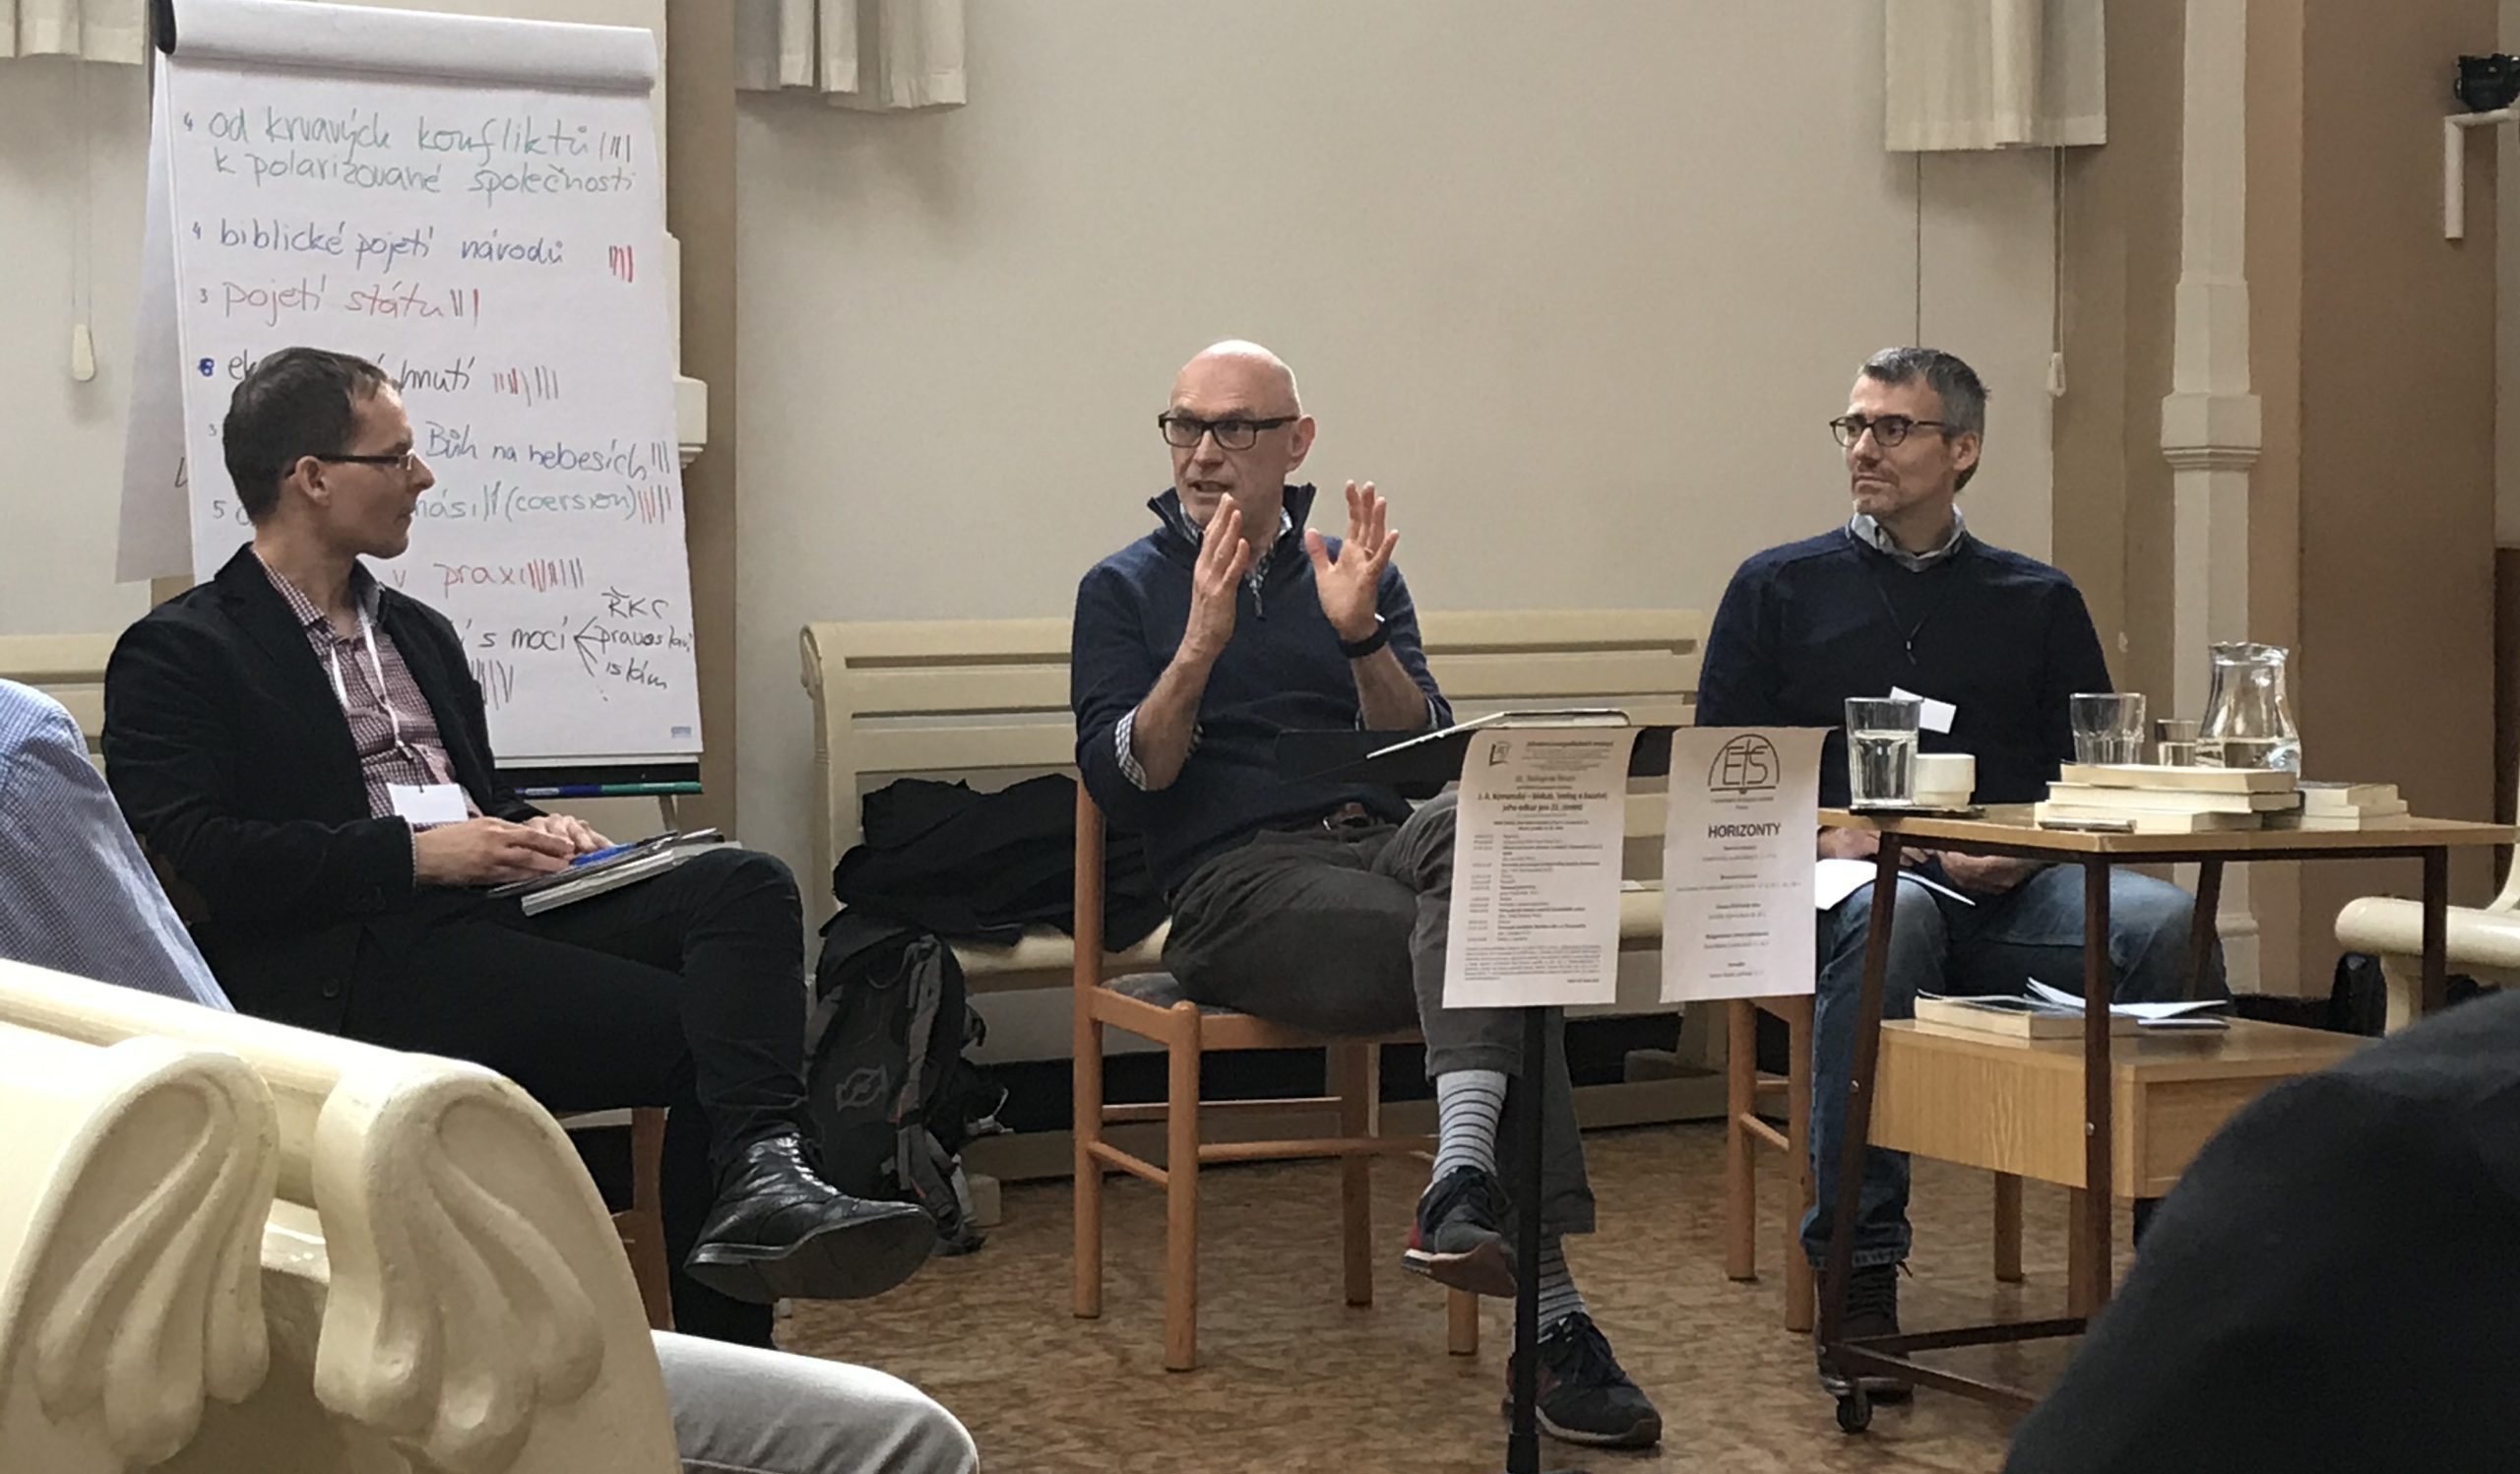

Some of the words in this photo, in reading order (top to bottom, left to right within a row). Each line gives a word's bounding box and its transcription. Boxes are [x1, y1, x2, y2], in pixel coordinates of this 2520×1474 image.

[209, 107, 248, 143] od
[244, 149, 442, 193] polarizované
[468, 161, 637, 209] společnosti
[220, 218, 346, 255] biblické
[355, 226, 433, 274] pojetí
[461, 228, 564, 265] národů
[222, 274, 327, 328] pojetí
[345, 281, 444, 318] státu
[425, 420, 478, 460] Bůh
[492, 445, 518, 463] na
[529, 438, 648, 481] nebesích
[213, 499, 226, 520] 5
[511, 615, 570, 651] mocí
[1708, 822, 1781, 839] HORIZONTY
